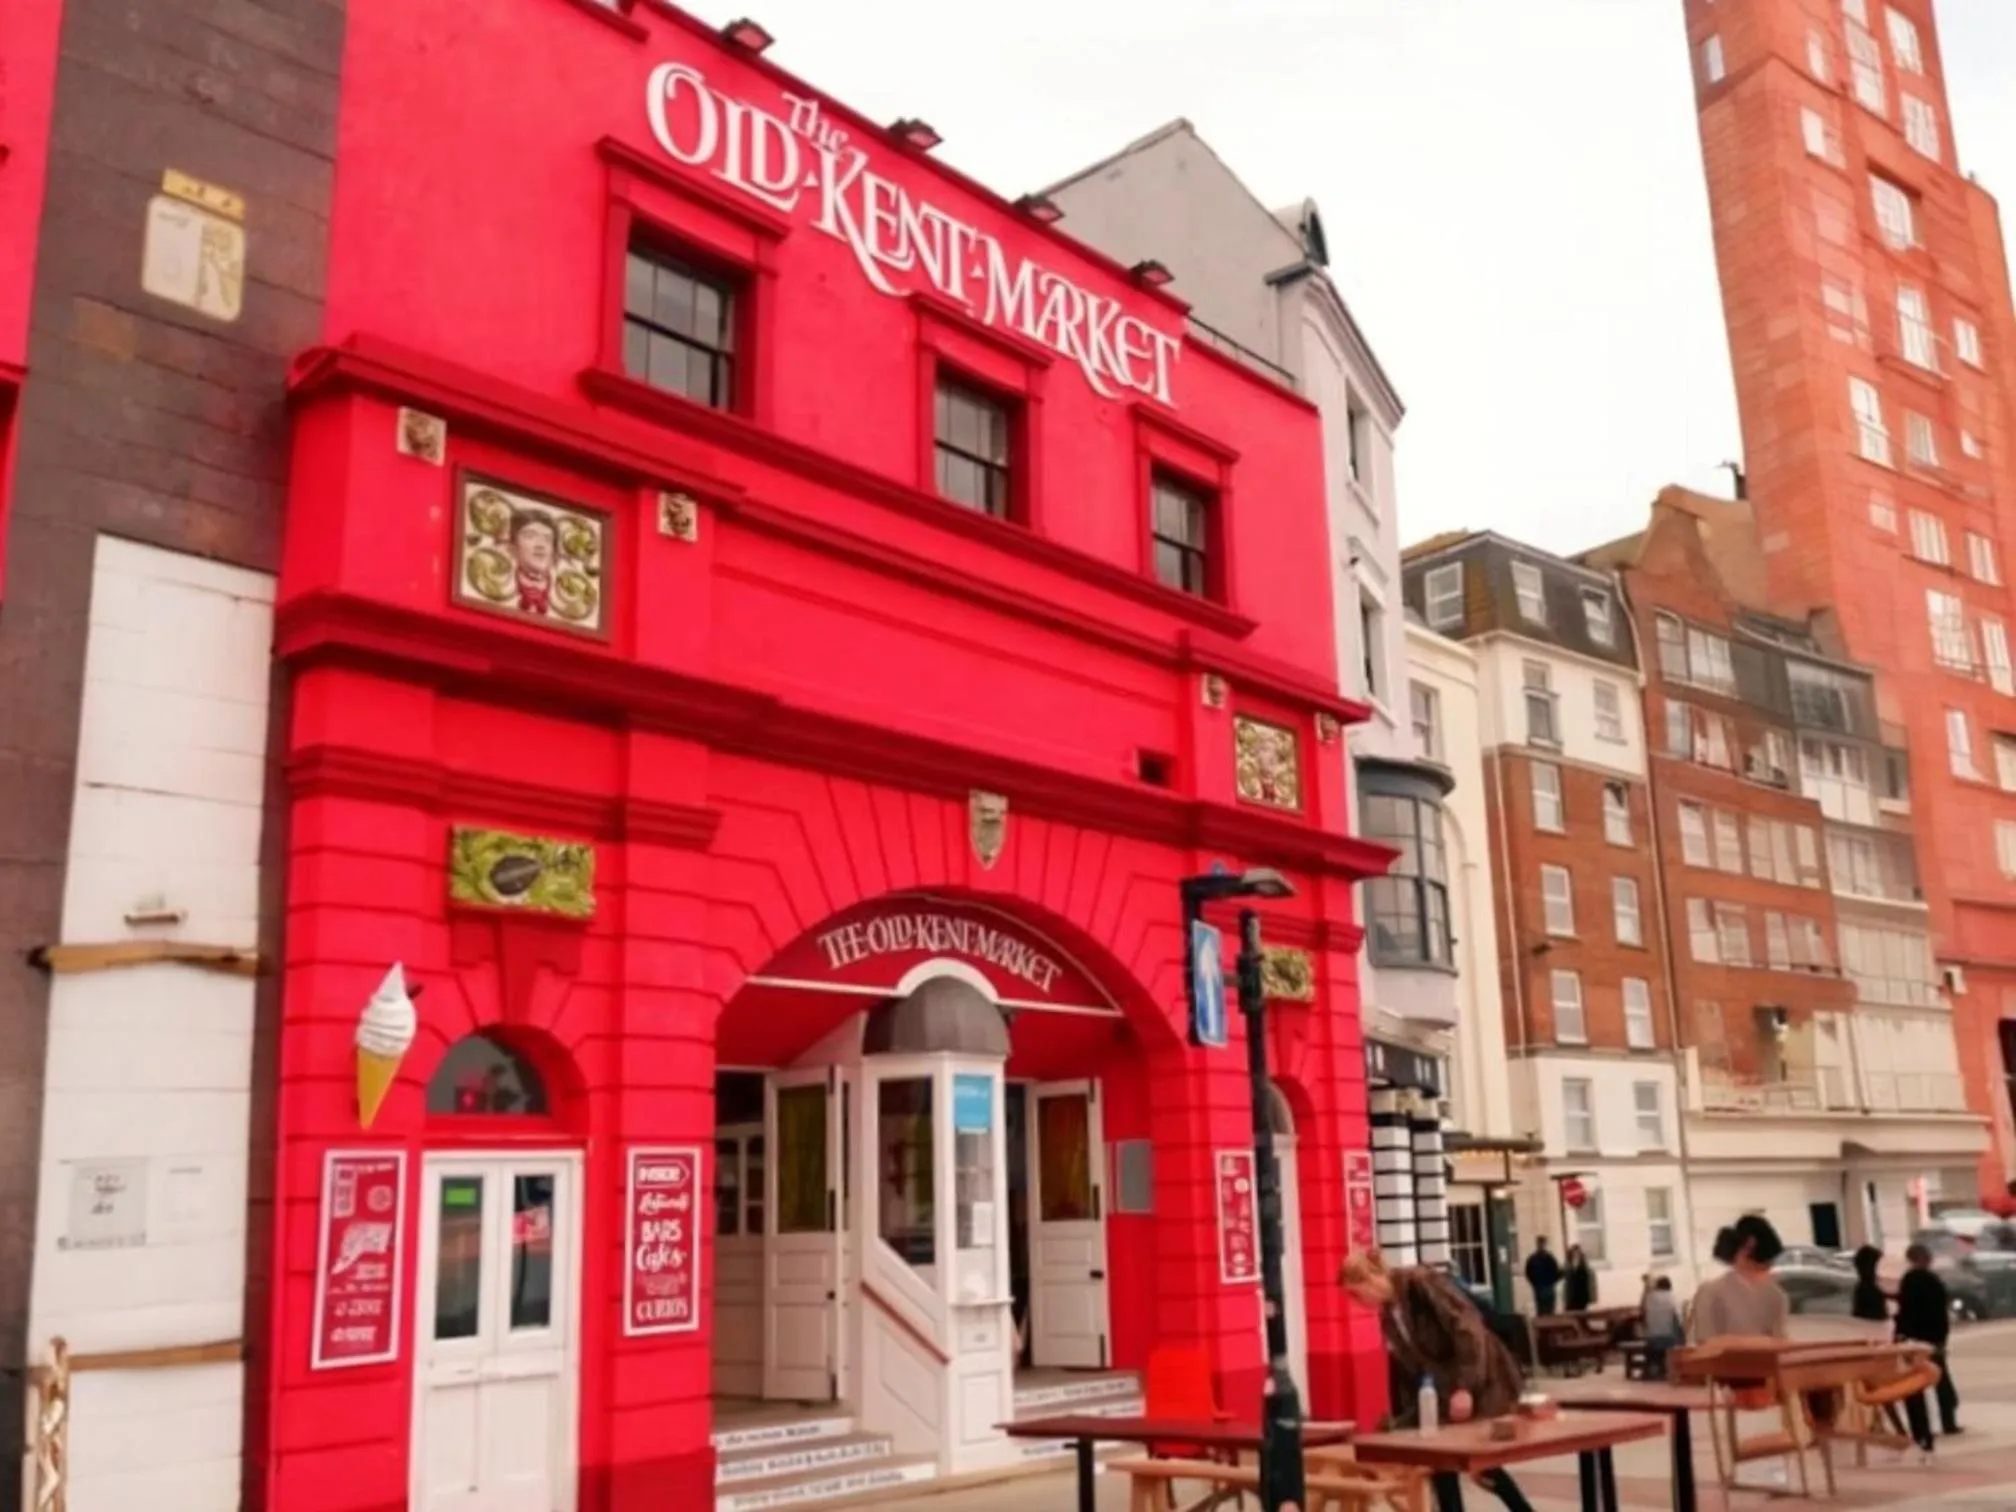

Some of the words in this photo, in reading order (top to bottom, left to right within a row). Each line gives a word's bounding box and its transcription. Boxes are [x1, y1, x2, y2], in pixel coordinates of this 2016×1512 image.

[781, 91, 850, 154] The
[646, 62, 799, 213] OLD
[809, 145, 977, 309] KENT
[973, 233, 1181, 409] MARKET
[816, 921, 869, 970] THE
[867, 915, 914, 954] OLD
[915, 914, 978, 954] KENT
[973, 925, 1063, 994] MARKET
